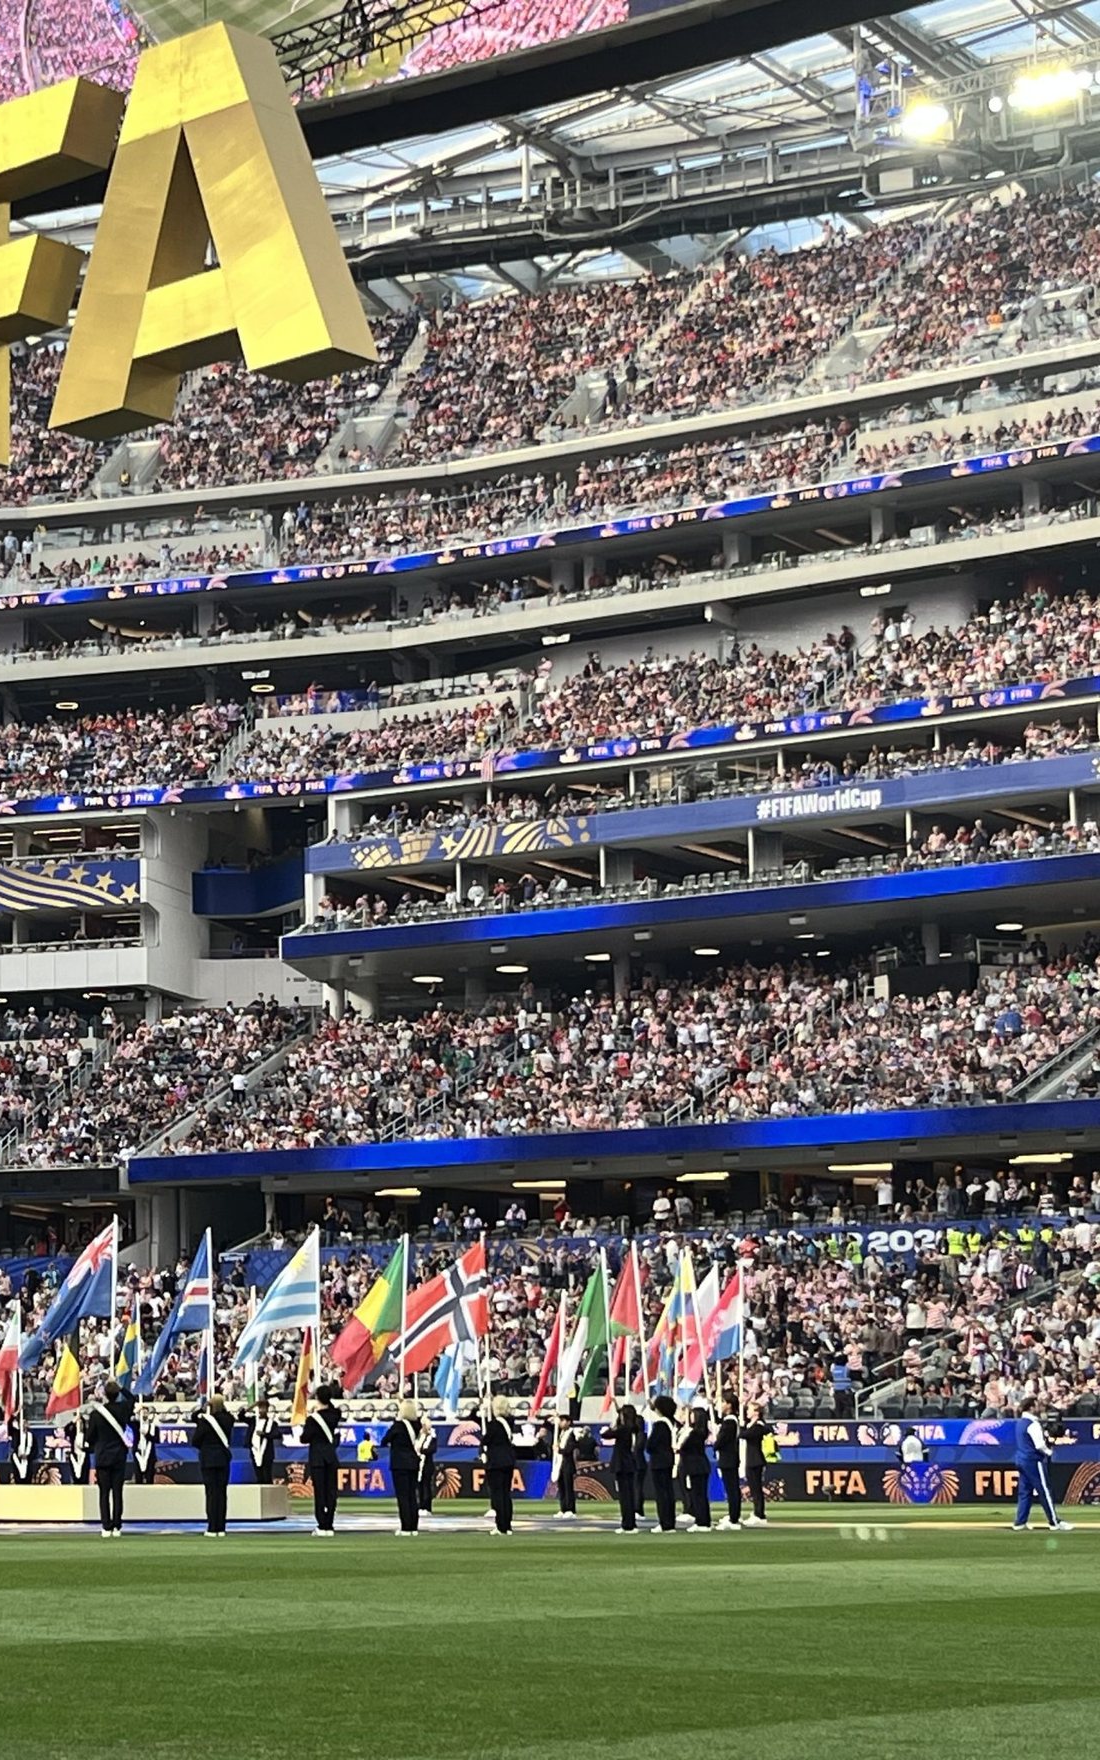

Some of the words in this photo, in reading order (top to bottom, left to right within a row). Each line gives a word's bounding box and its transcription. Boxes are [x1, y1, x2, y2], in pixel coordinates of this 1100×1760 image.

[756, 788, 882, 820] #FIFAWorldCup
[867, 1229, 943, 1252] 202
[160, 1430, 187, 1443] FIFA
[814, 1425, 849, 1441] FIFA
[337, 1469, 385, 1491] FIFA
[473, 1469, 526, 1492] FA
[805, 1470, 867, 1495] FIFA
[975, 1470, 1020, 1496] FIF
